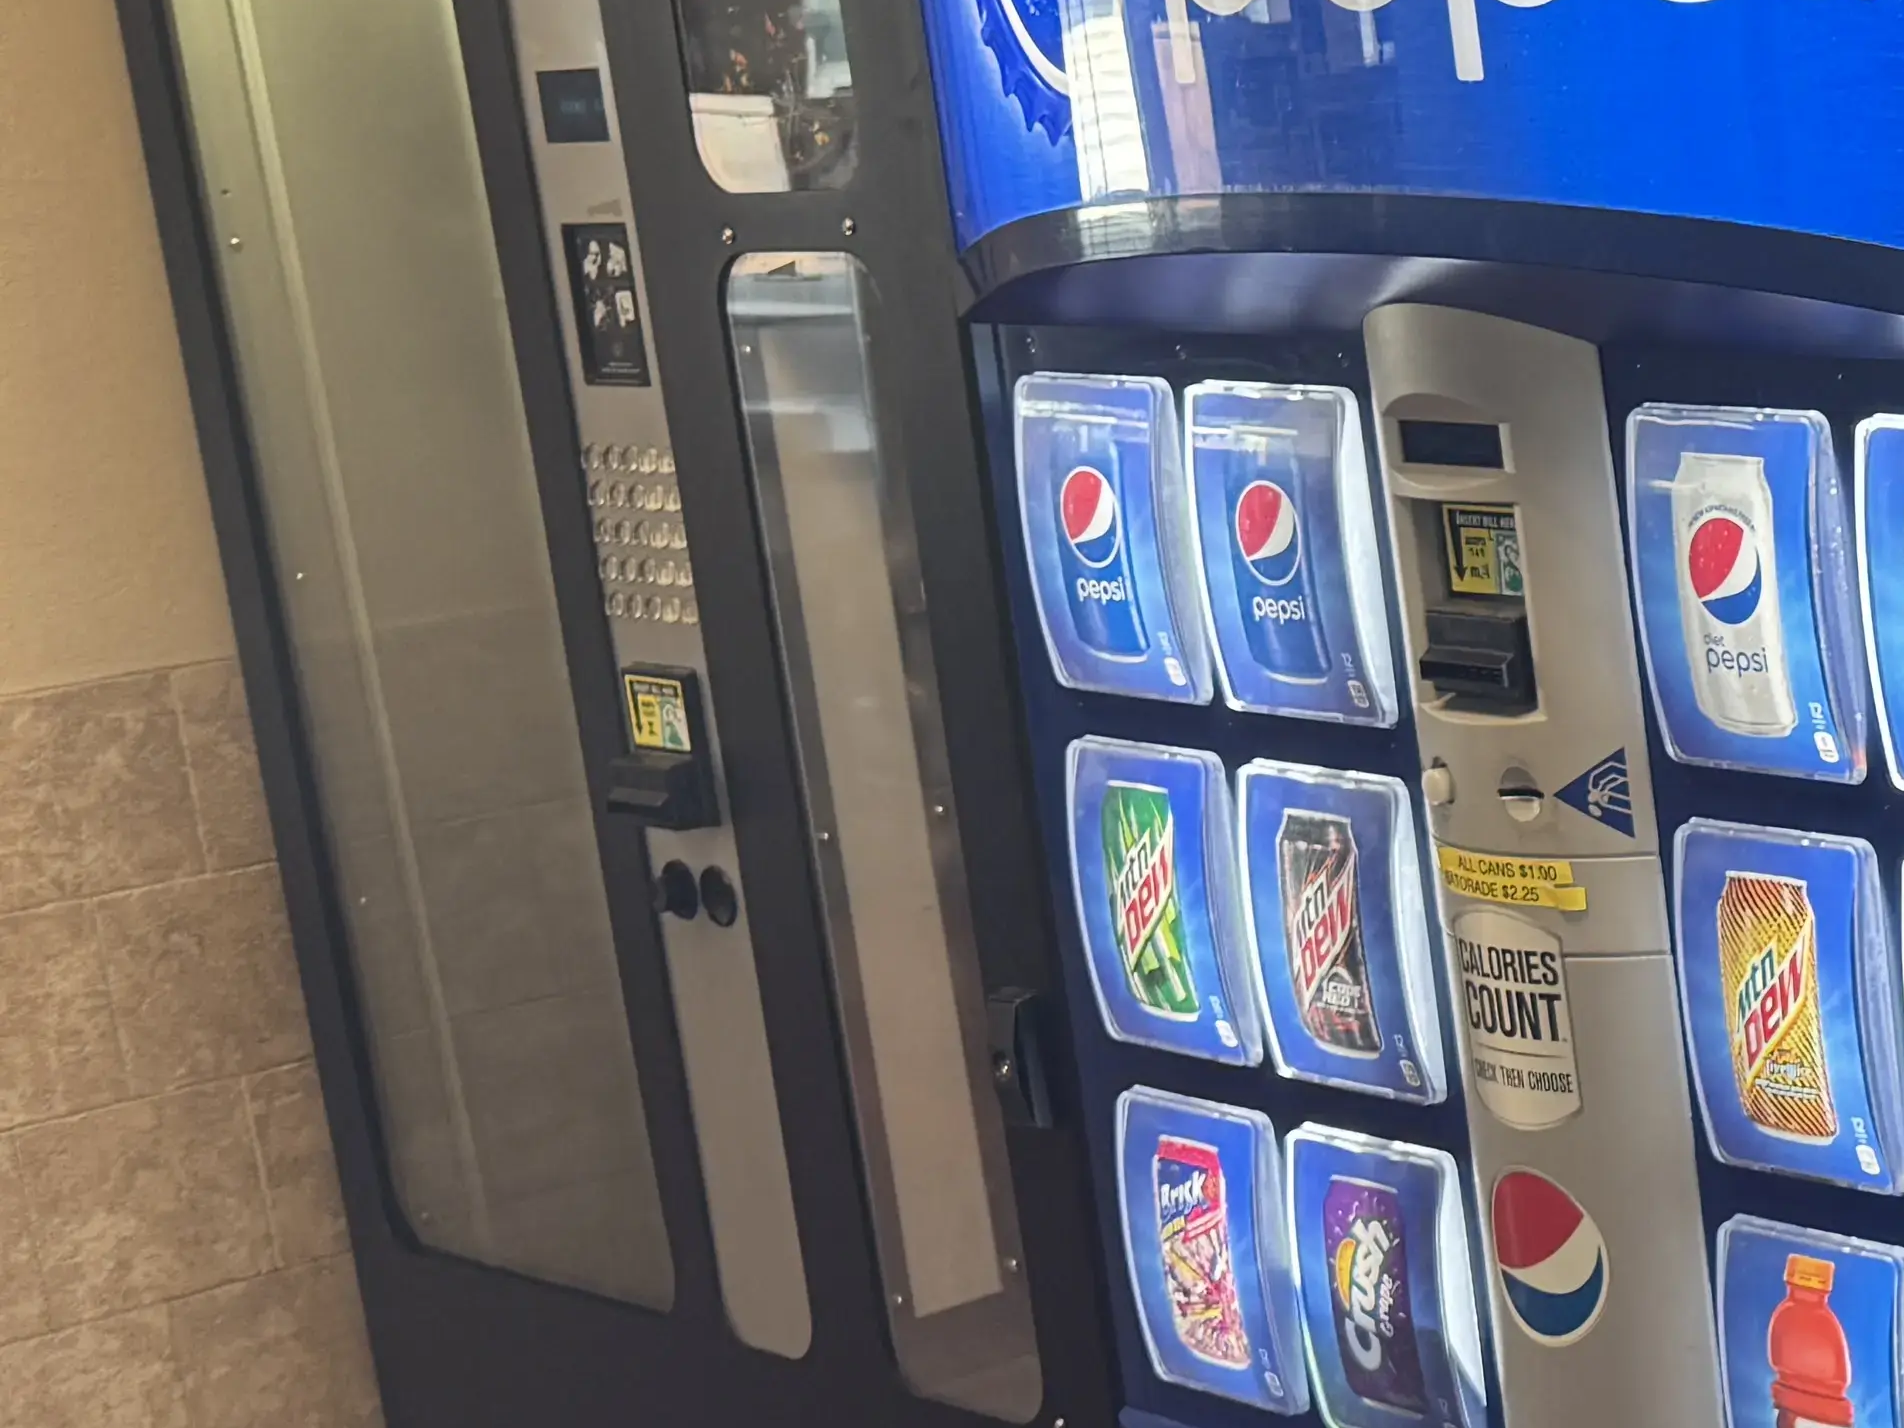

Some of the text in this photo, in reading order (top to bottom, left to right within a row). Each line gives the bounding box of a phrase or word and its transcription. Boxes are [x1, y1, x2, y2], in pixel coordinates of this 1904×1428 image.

[1456, 510, 1480, 524] INSERT
[1077, 575, 1126, 606] pepsi
[1253, 595, 1306, 626] pepsi
[1703, 632, 1725, 648] diet
[1705, 646, 1770, 679] pepsi
[1458, 855, 1557, 881] ALL CANS $1.00
[1502, 885, 1540, 902] $2.25
[1458, 936, 1560, 987] CALORIES
[1464, 979, 1562, 1043] COUNT
[1500, 1064, 1574, 1094] THEN CHOOSE
[1161, 1170, 1207, 1223] Brisk
[1344, 1218, 1389, 1370] Crush
[1379, 1273, 1399, 1338] Grape
